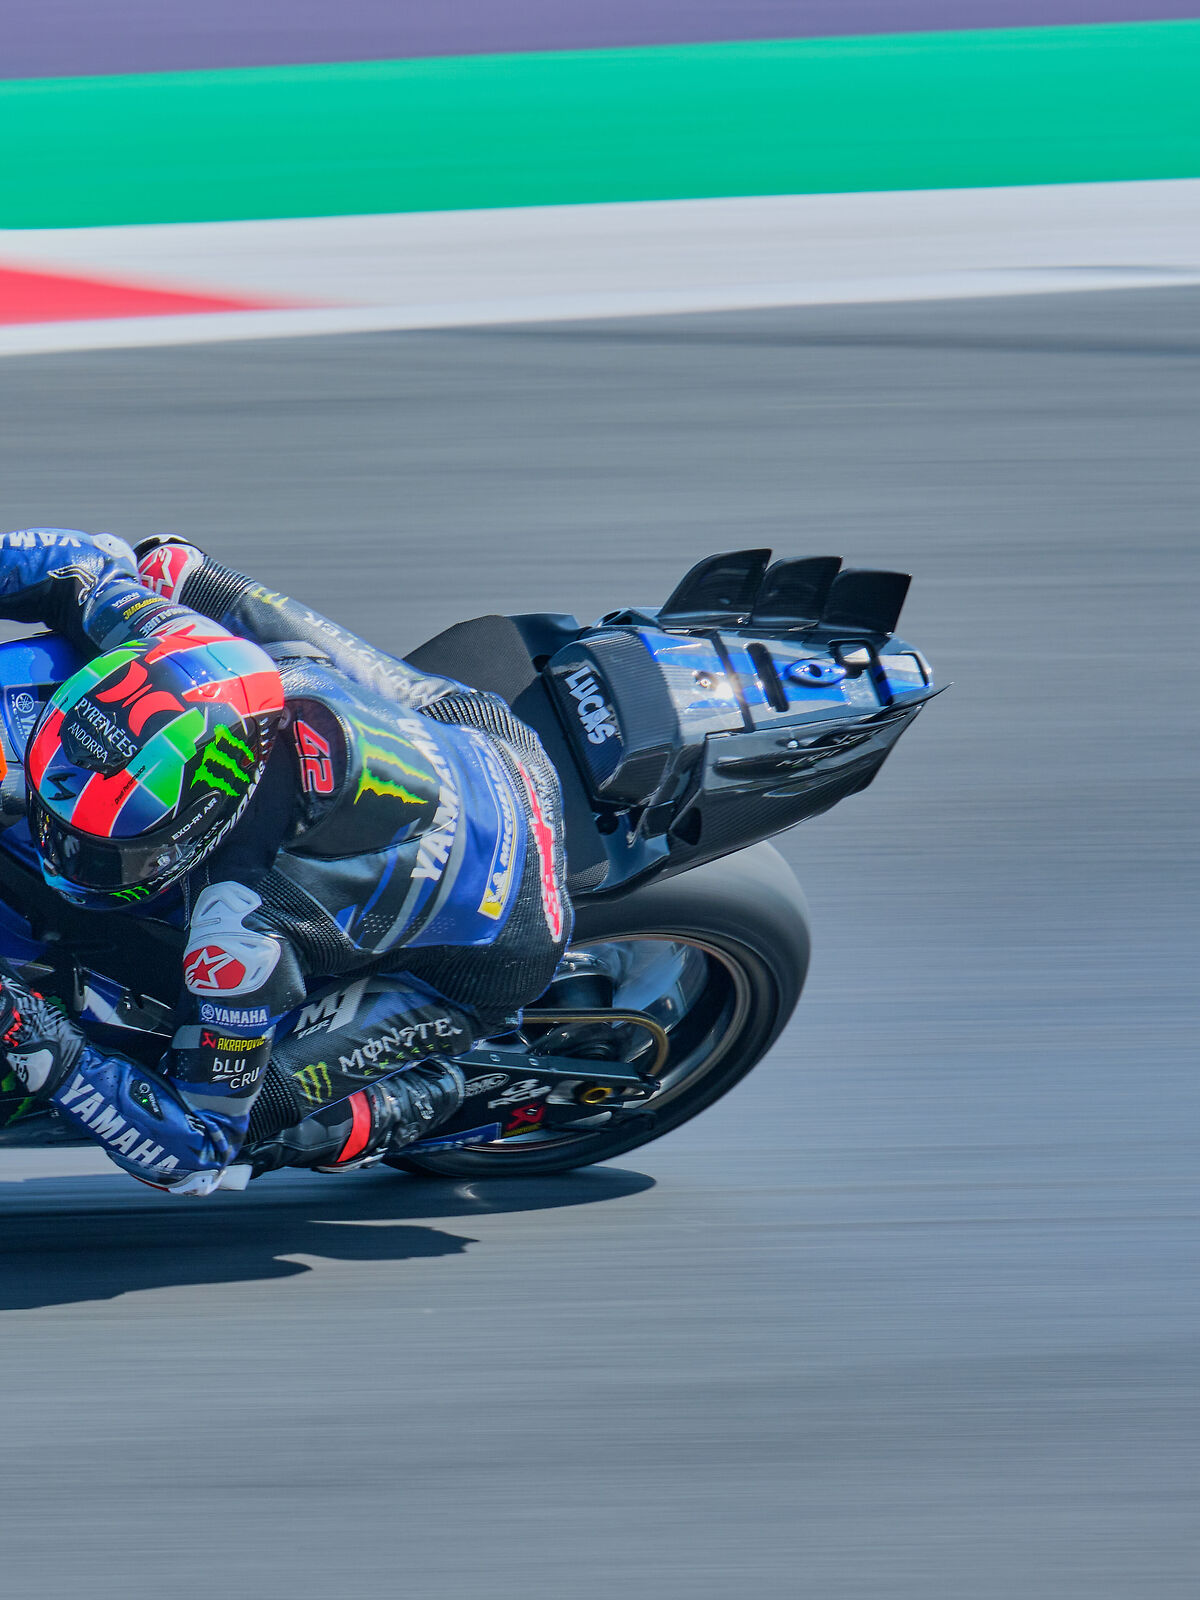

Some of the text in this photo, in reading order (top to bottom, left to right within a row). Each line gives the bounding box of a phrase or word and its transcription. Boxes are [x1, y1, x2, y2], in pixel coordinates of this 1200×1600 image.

[565, 666, 617, 745] LUCAS
[67, 722, 108, 763] ANDORRA
[293, 720, 334, 793] 42
[203, 797, 218, 815] AIR
[215, 1008, 268, 1024] YAMAHA
[60, 1074, 180, 1170] YAMAHA
